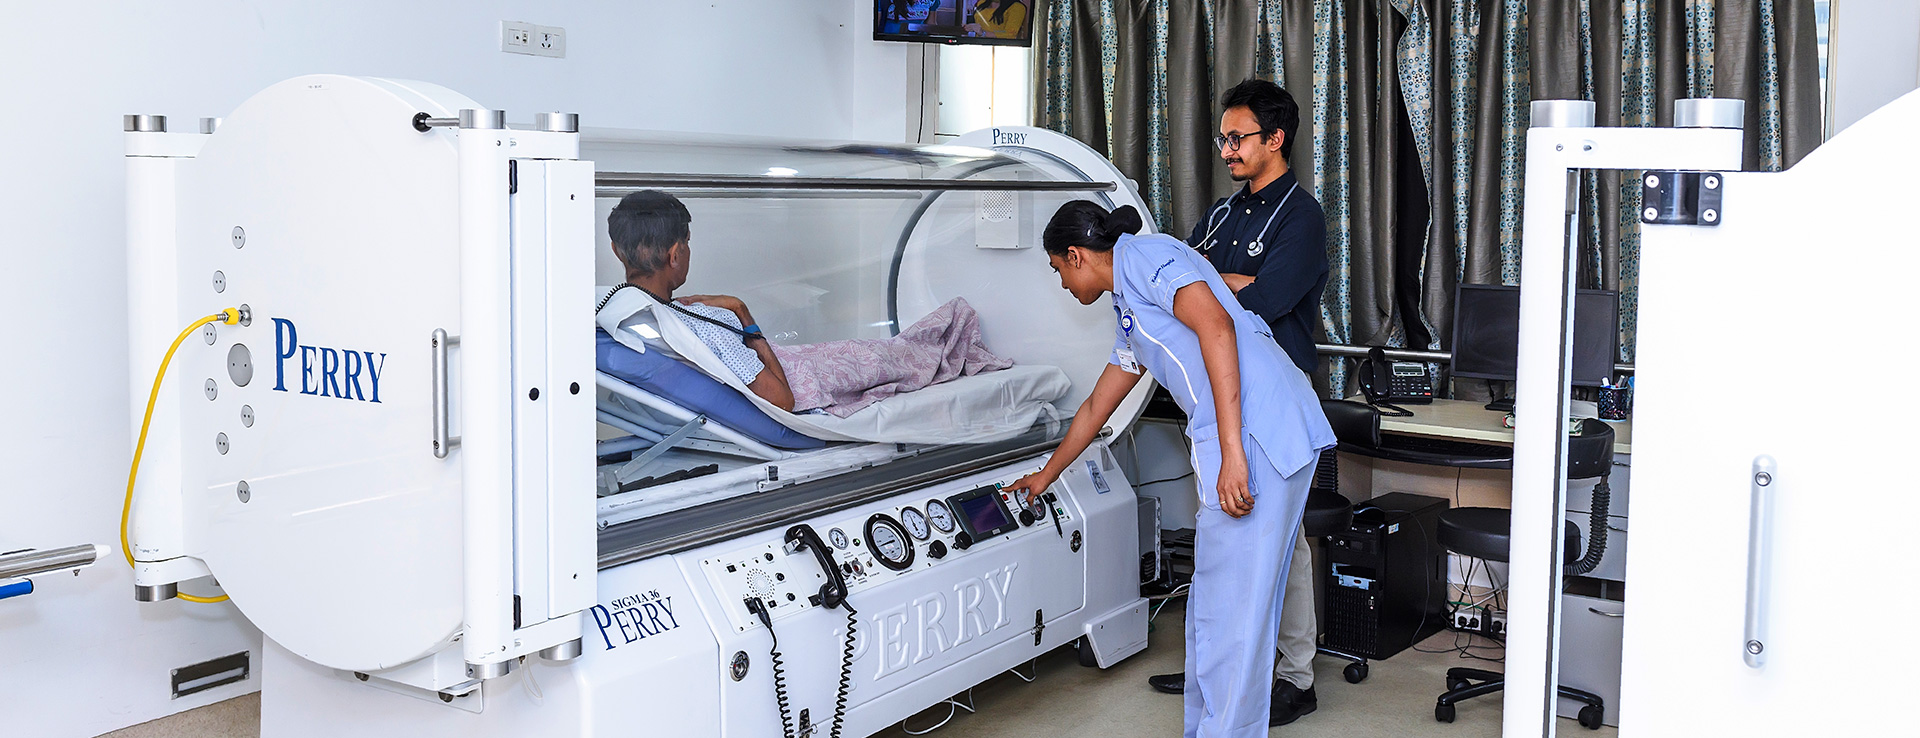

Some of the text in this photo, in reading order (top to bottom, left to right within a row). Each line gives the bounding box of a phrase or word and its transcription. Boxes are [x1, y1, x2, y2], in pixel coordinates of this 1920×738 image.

[992, 128, 1028, 145] PERRY
[271, 317, 387, 404] PERRY
[589, 596, 681, 651] PERRY
[611, 588, 660, 610] SIGMA 36
[833, 562, 1019, 699] PERRY
